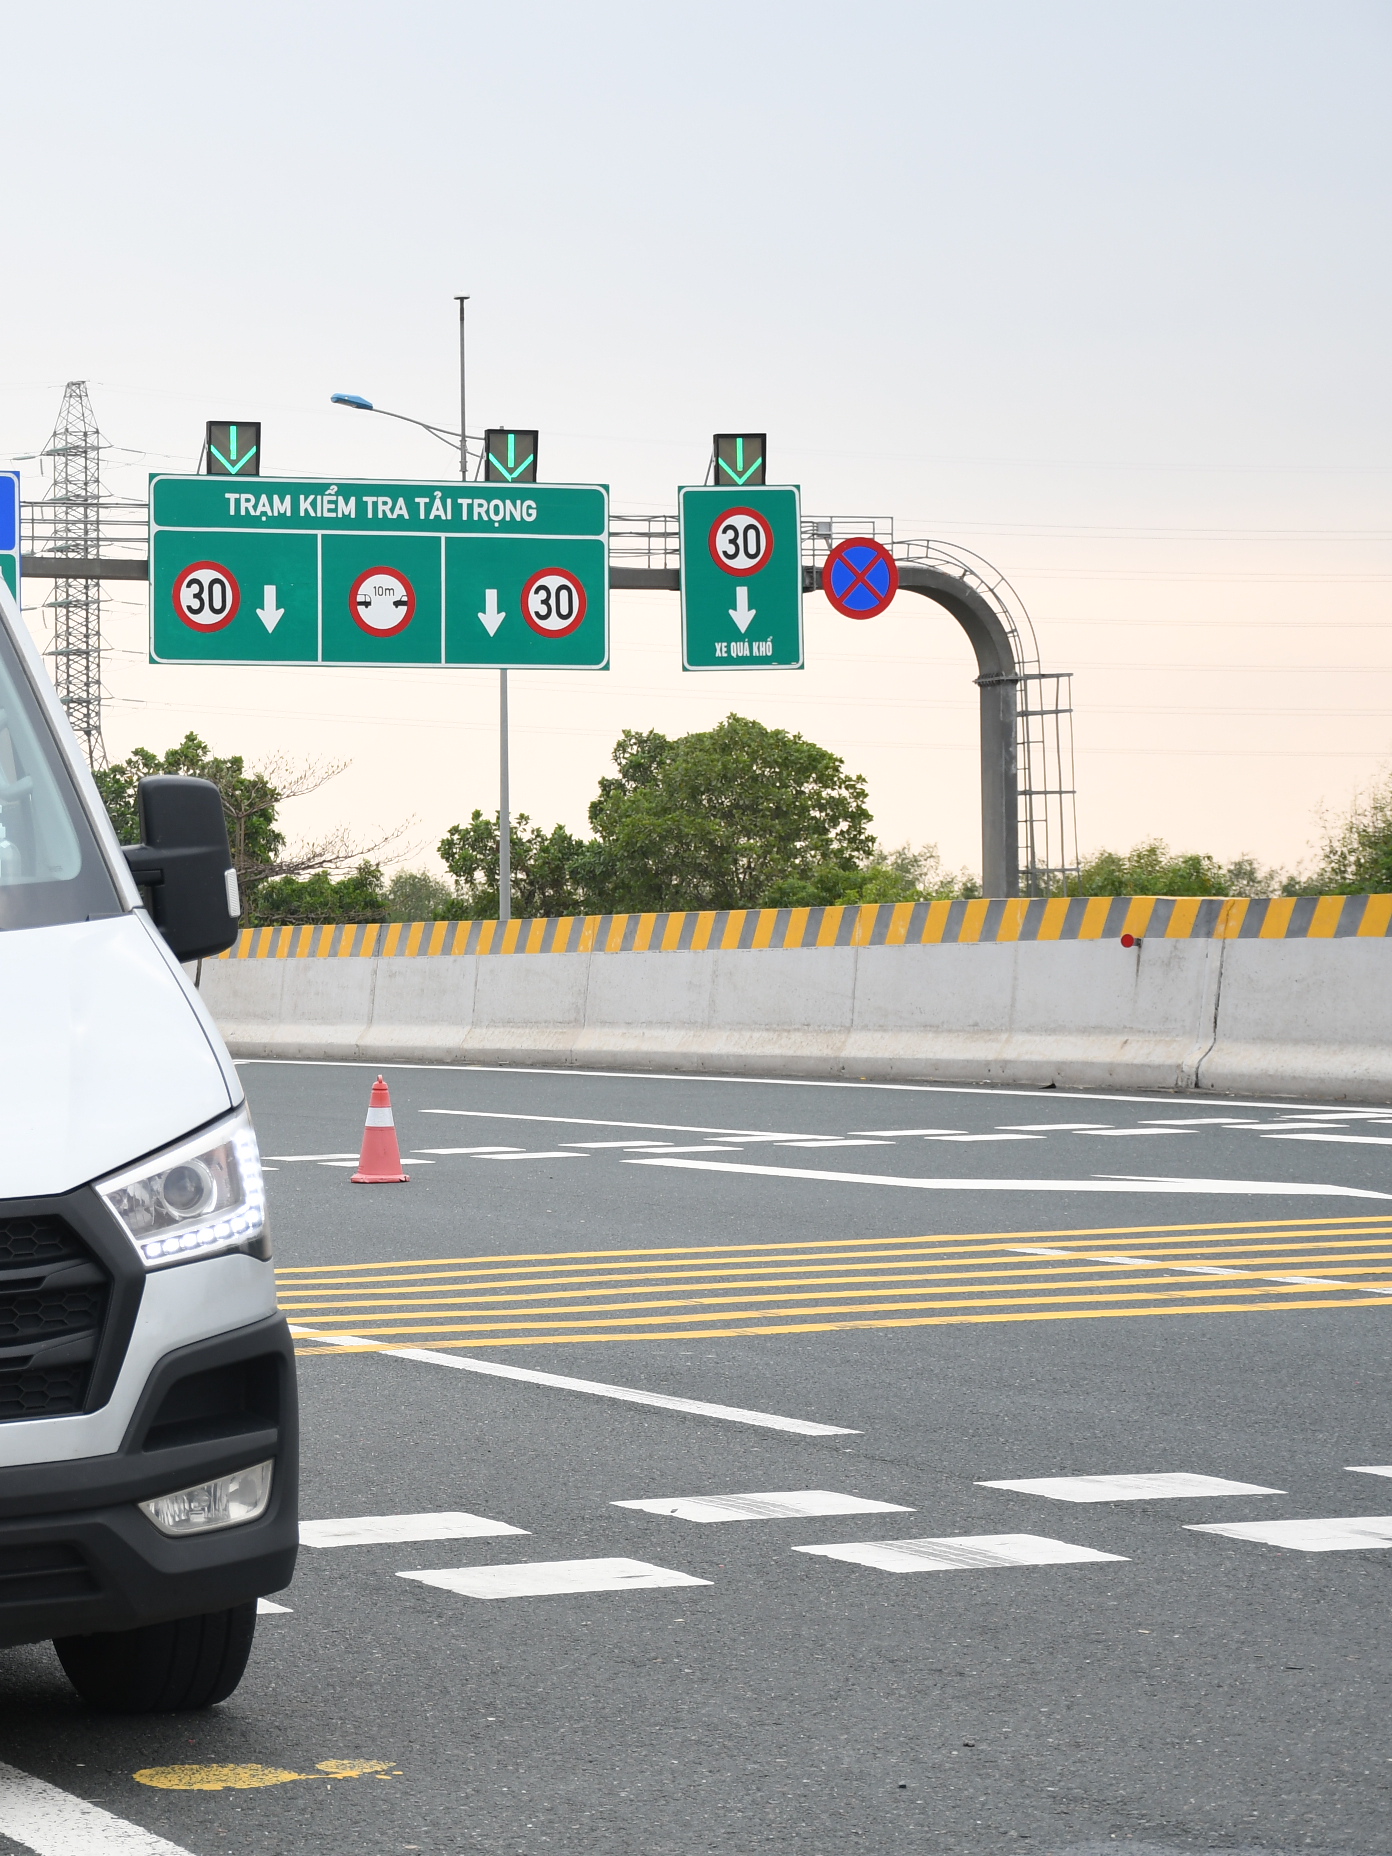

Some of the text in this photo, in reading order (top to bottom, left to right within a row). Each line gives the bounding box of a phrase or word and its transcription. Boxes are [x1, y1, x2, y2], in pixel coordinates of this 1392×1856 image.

[224, 485, 537, 527] TRẠM KIỂM TRA TẢI TRỌNG
[721, 523, 761, 560] 30
[185, 577, 227, 615] 30
[373, 585, 395, 597] 10m
[533, 584, 574, 621] 30
[715, 642, 728, 657] XE
[730, 638, 751, 658] QUÁ
